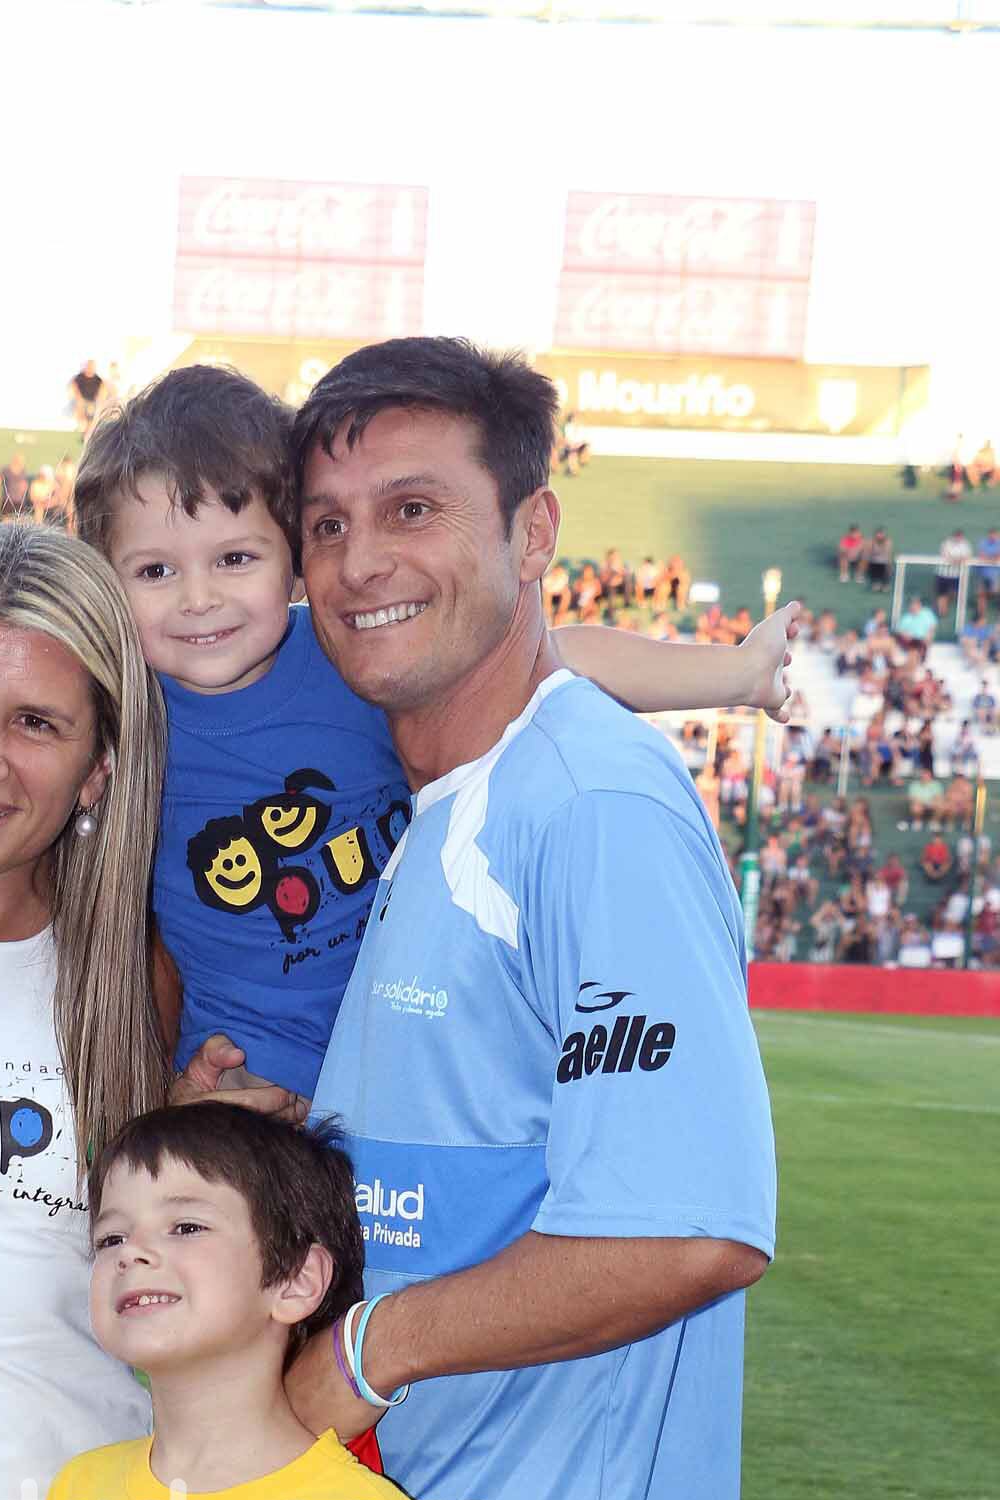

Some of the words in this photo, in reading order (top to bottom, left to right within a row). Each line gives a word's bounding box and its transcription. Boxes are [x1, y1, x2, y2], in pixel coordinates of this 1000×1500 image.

[282, 944, 321, 974] por
[327, 931, 350, 948] un
[556, 1014, 676, 1084] aelle
[12, 1178, 90, 1217] integra
[352, 1176, 424, 1220] alud
[373, 1221, 421, 1248] Privada
